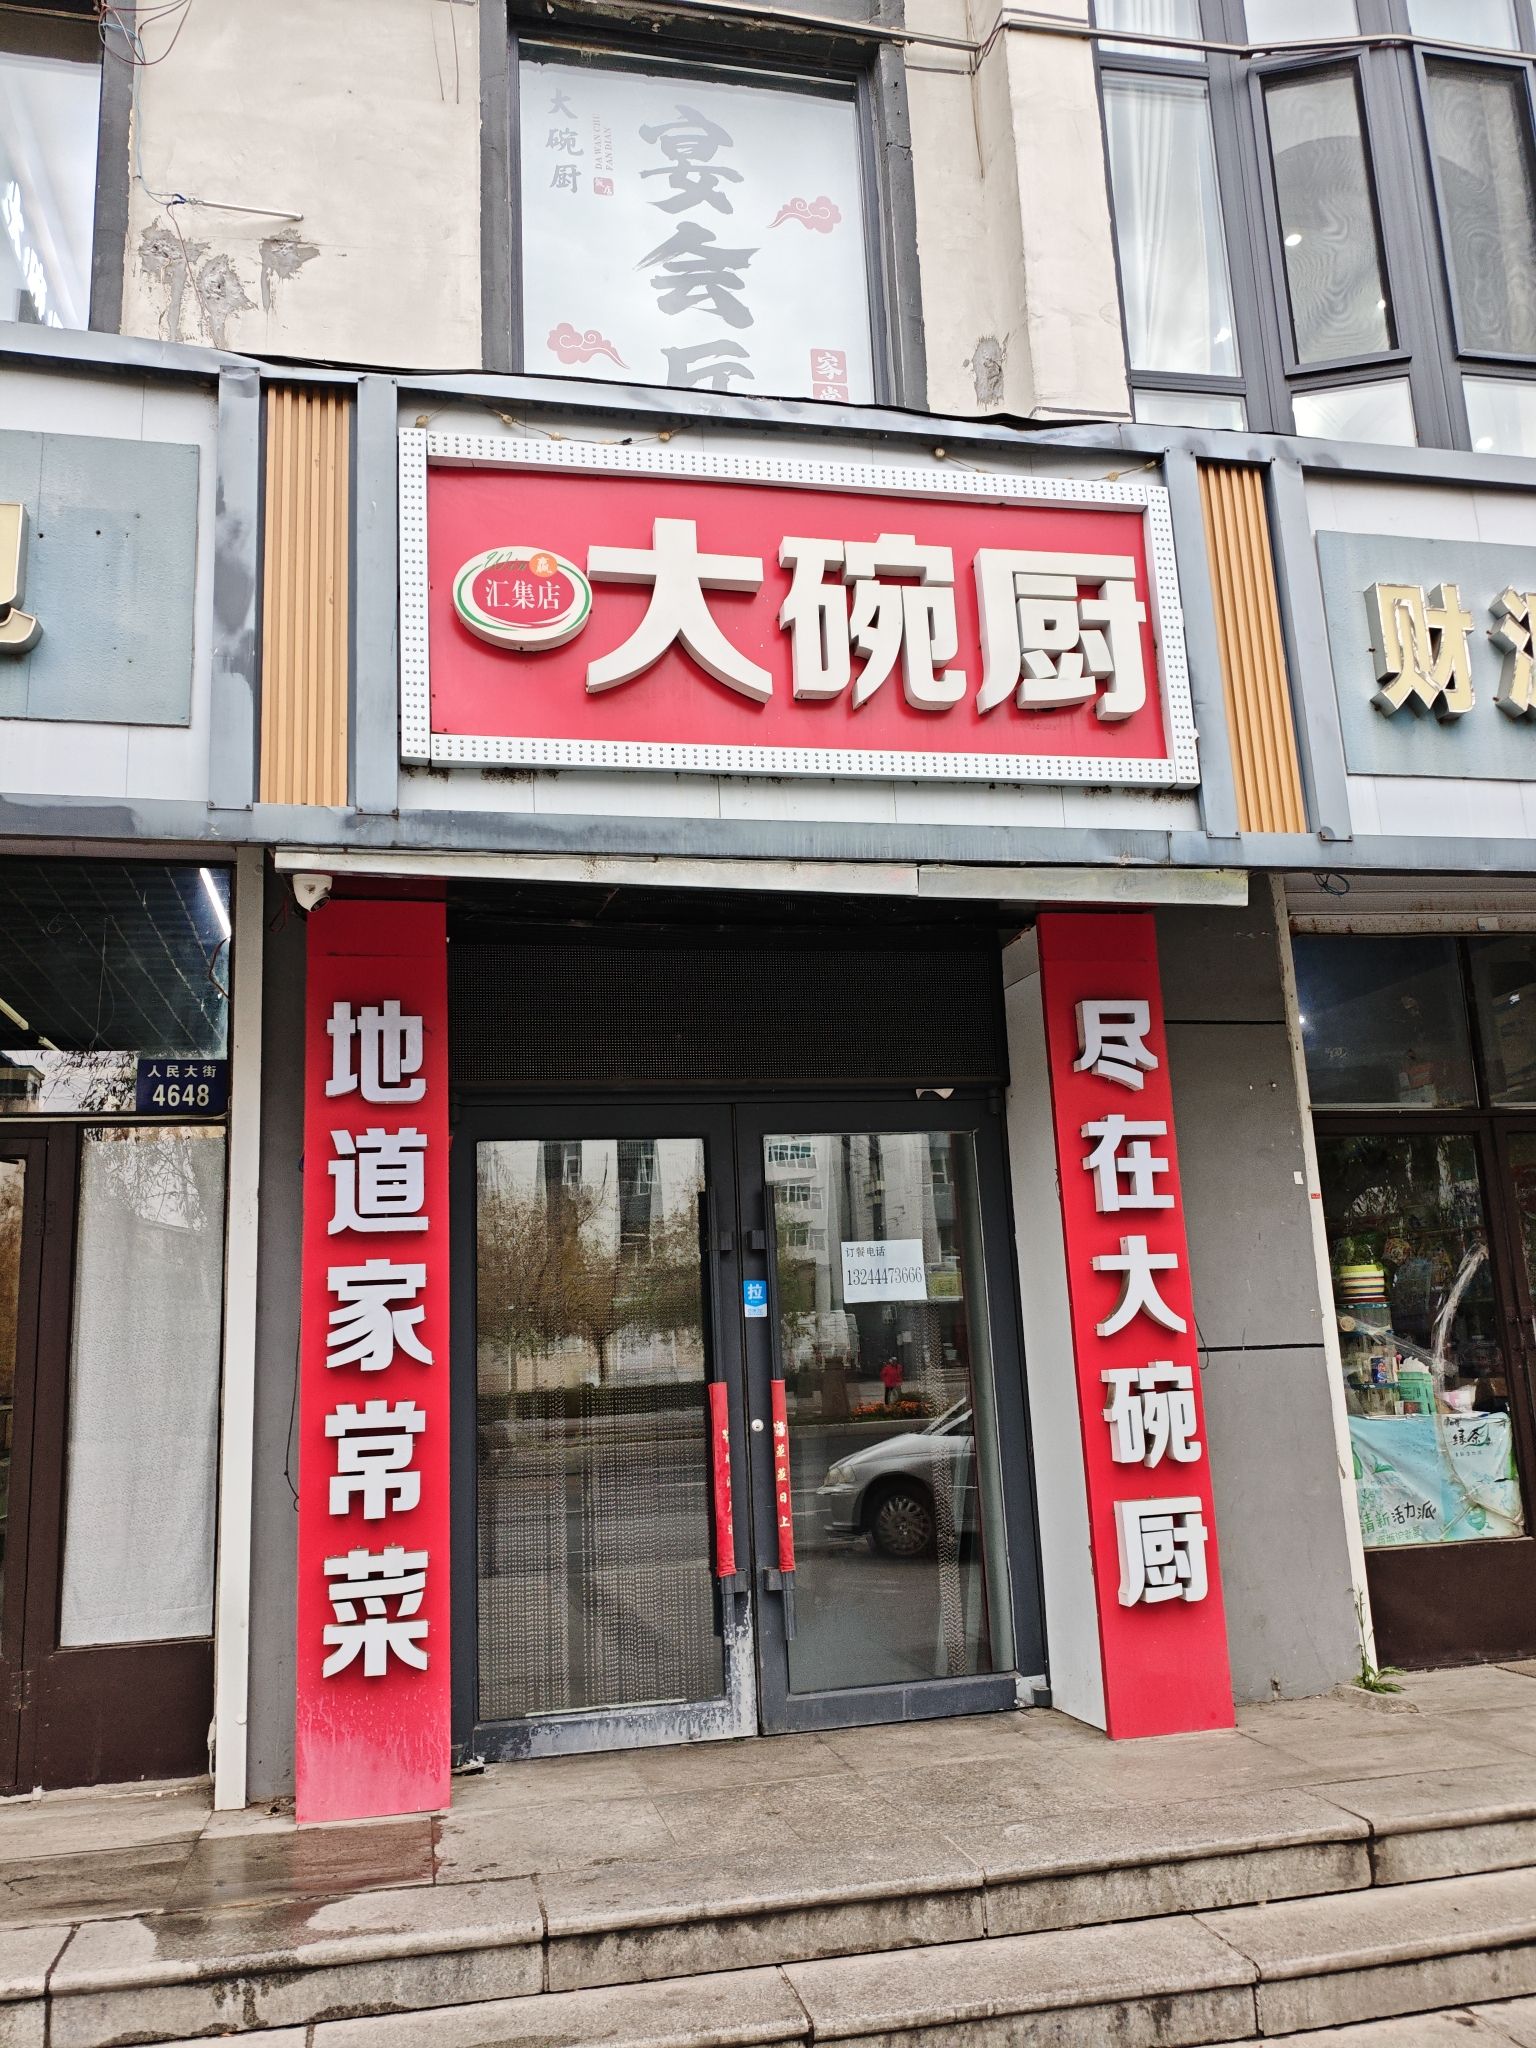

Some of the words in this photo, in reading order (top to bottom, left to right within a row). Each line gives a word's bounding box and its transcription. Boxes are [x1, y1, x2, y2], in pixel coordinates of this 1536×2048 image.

[545, 88, 584, 193] 大碗厨
[484, 578, 561, 610] 汇集店
[586, 517, 1147, 721] 大碗厨
[147, 1064, 217, 1078] 人民大街
[152, 1084, 210, 1107] 4648
[846, 1246, 886, 1257] 订餐电话
[847, 1267, 923, 1286] 13244473666
[747, 1283, 763, 1300] 拉
[1073, 1000, 1208, 1607] 尽在大碗厨
[323, 1000, 435, 1678] 地道家常菜
